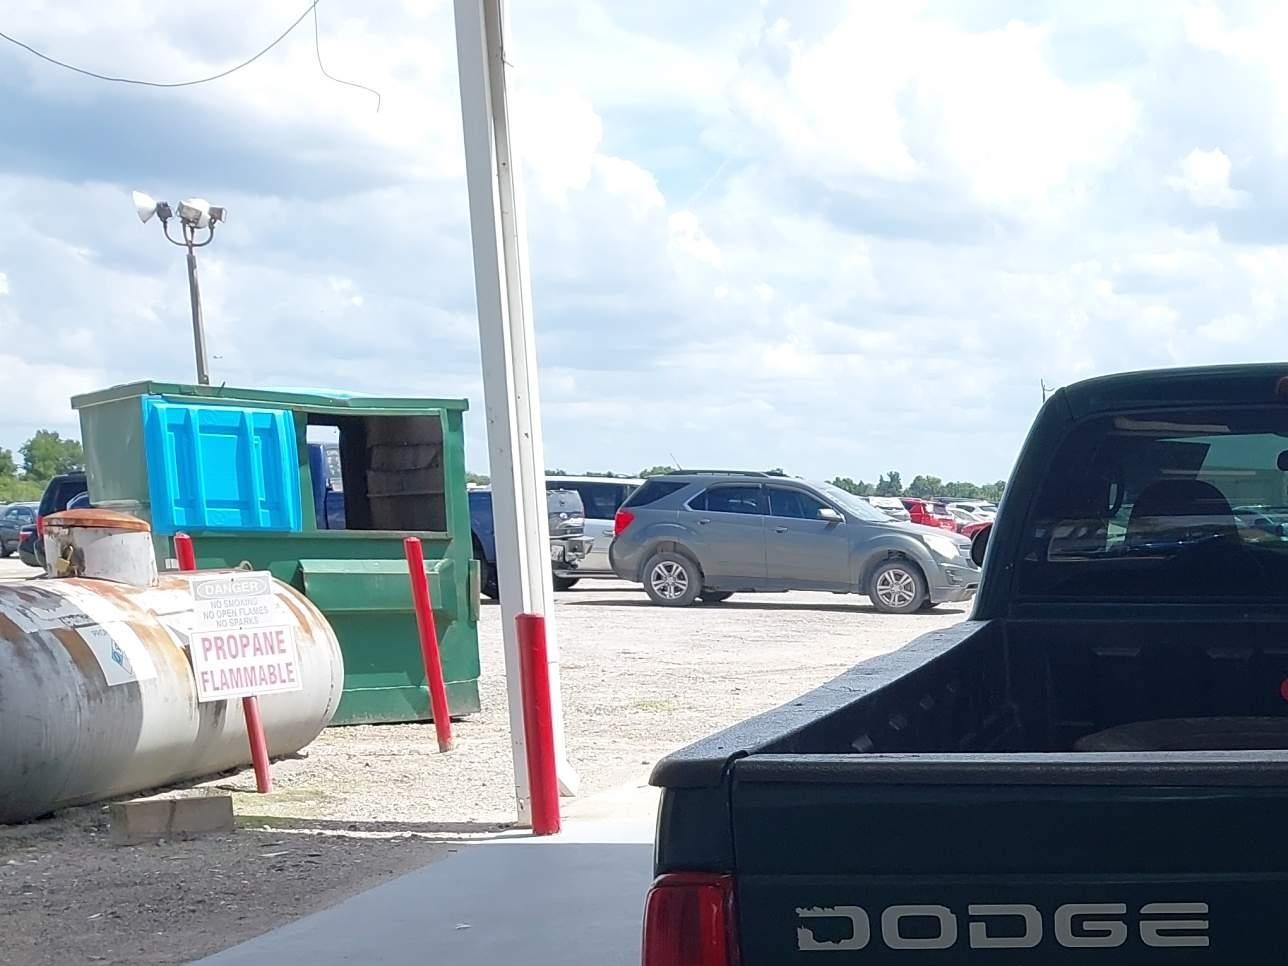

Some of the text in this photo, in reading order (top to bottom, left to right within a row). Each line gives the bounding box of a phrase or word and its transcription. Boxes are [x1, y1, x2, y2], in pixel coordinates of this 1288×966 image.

[205, 582, 258, 595] DANGER
[210, 600, 222, 609] NO
[203, 606, 269, 620] NO OPEN FLAMES
[216, 616, 259, 628] NO SPARKS
[201, 630, 287, 662] PROPANE
[200, 662, 296, 693] FLAMMABLE
[796, 902, 1210, 950] DODGE
